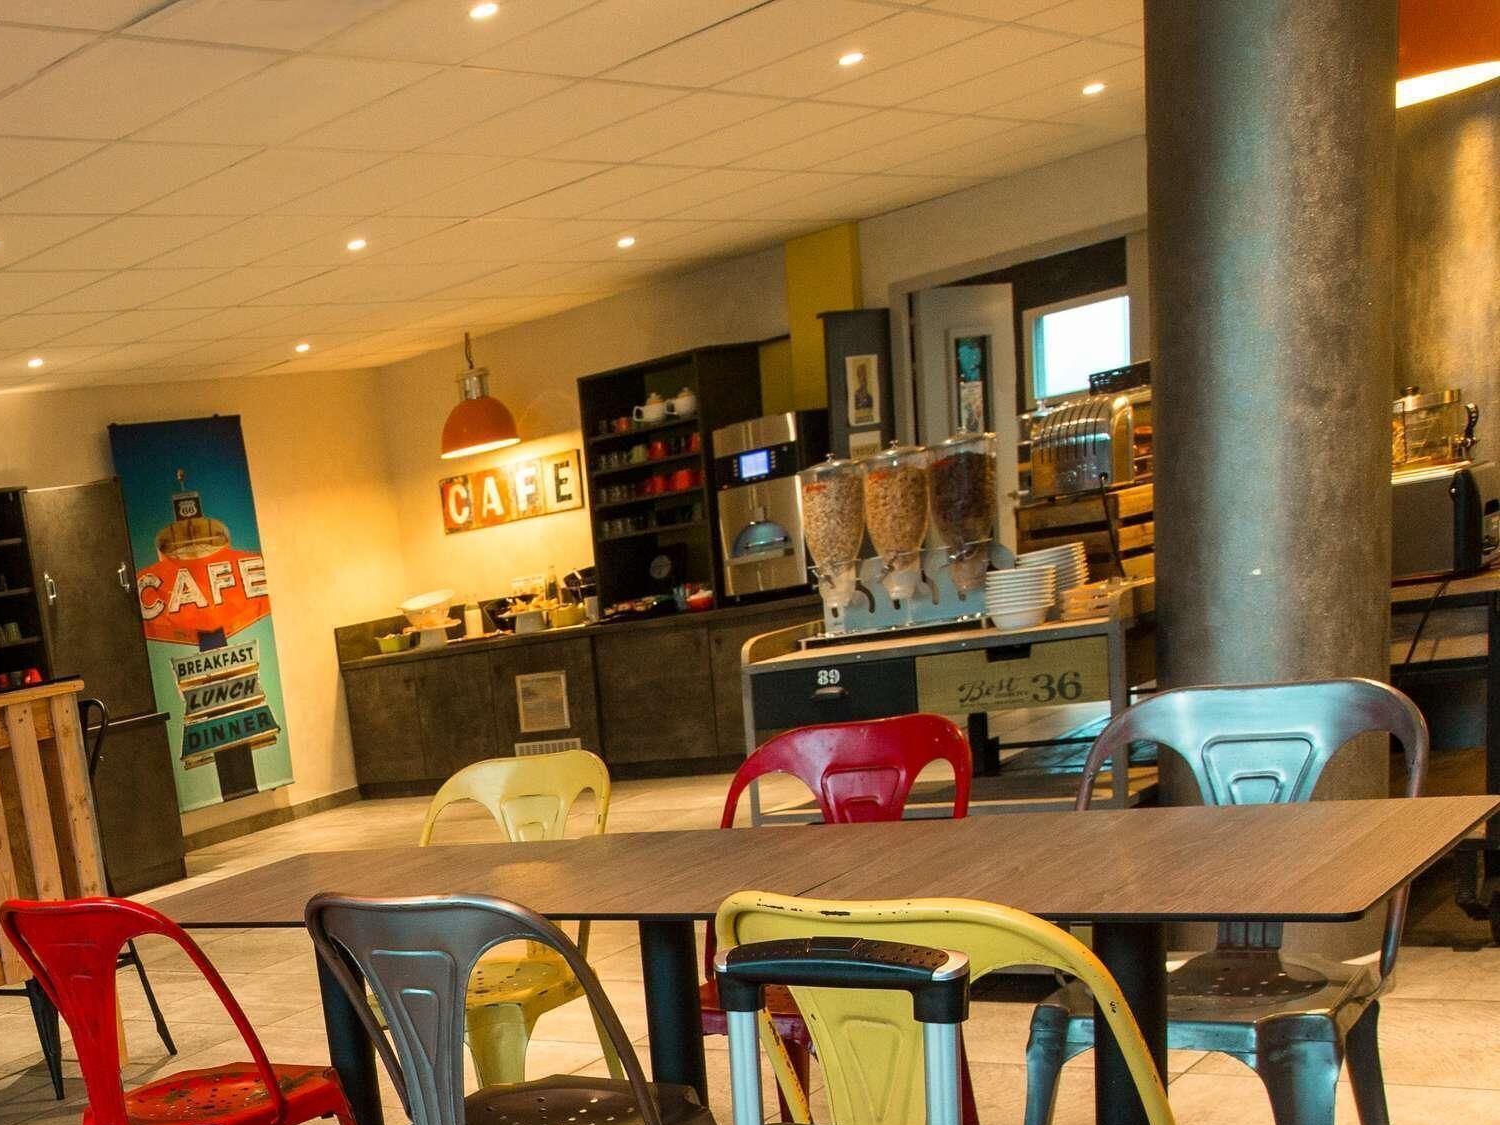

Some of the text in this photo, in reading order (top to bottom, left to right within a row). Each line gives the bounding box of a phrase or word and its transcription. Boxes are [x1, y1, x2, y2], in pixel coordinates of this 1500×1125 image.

[448, 459, 573, 525] CAFE
[137, 556, 269, 621] CAFE
[177, 646, 254, 678] BREAKFAST
[816, 668, 840, 686] 89
[189, 677, 258, 711] LUNCH
[1032, 670, 1083, 702] 36
[187, 710, 272, 749] DINNER
